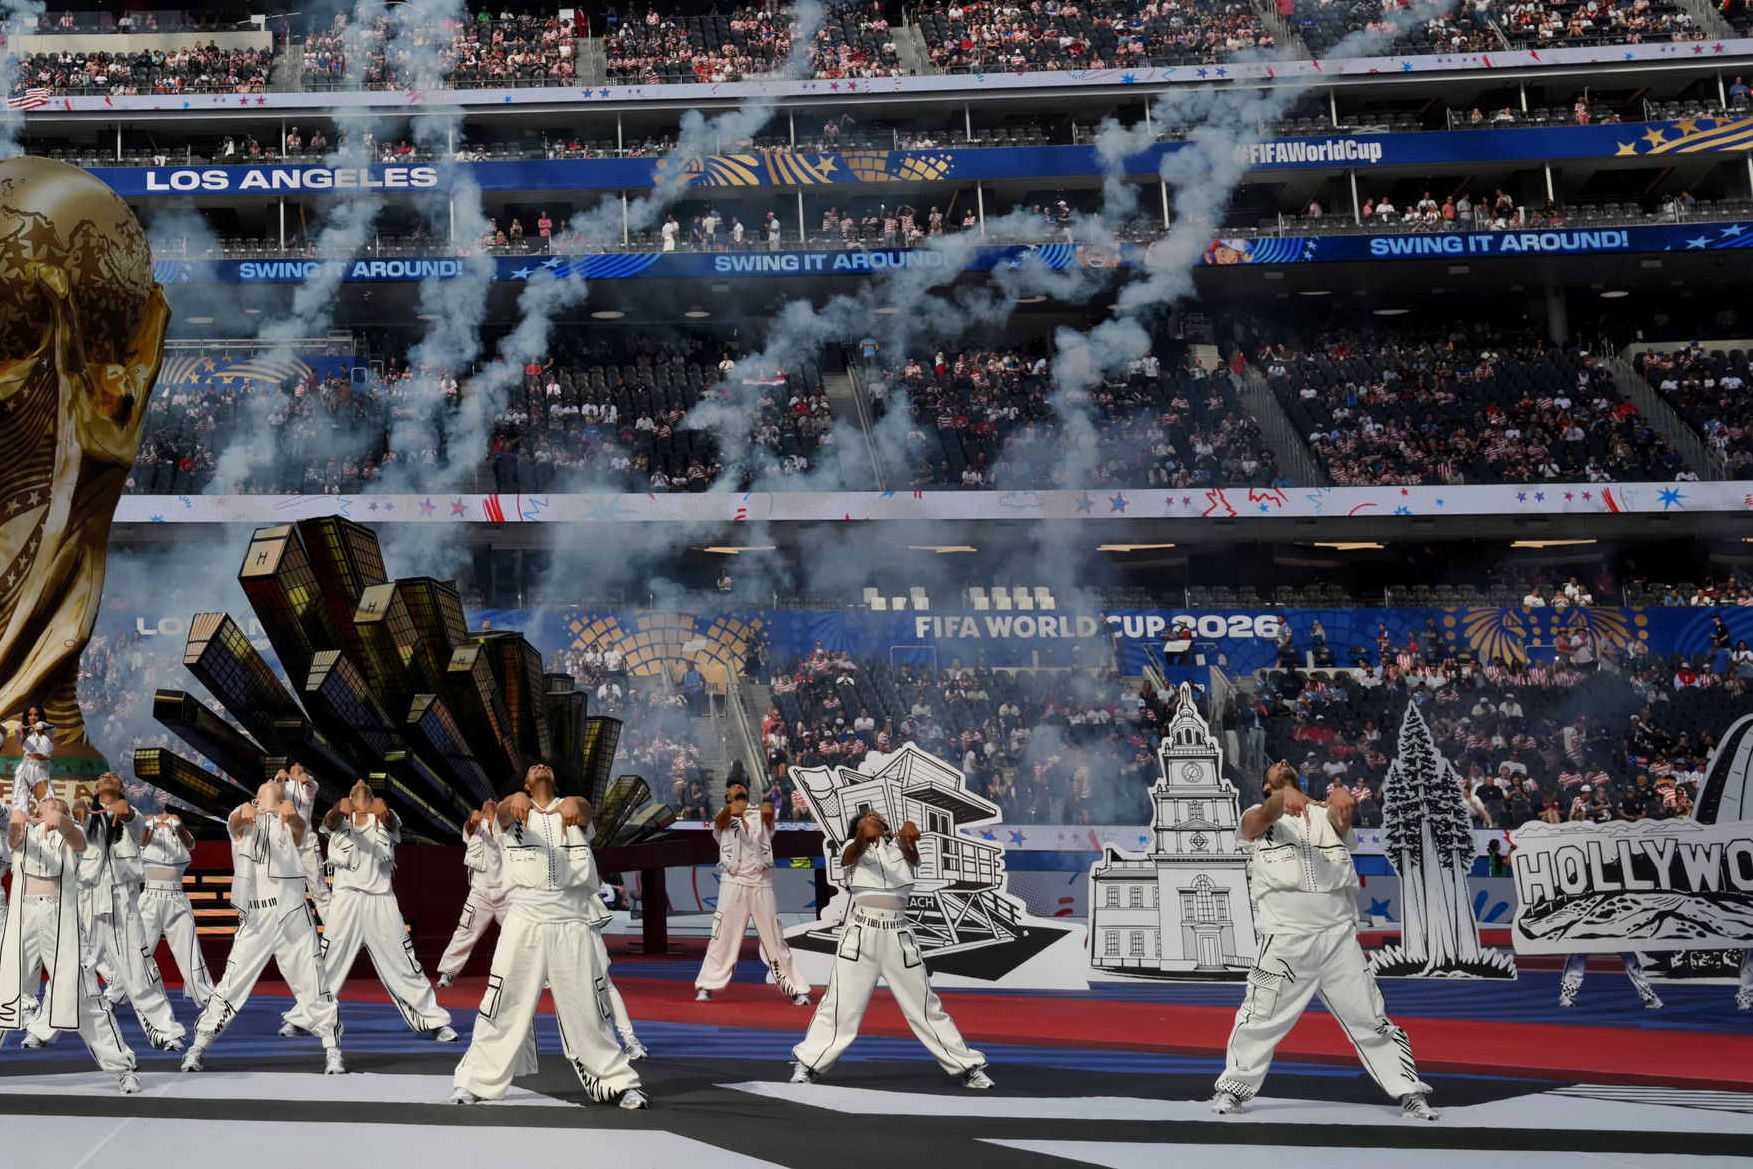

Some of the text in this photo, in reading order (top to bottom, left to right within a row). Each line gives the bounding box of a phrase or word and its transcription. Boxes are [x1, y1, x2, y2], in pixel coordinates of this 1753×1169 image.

[1231, 139, 1382, 164] #FIFAWorldCup
[146, 167, 438, 190] LOS ANGELES
[1370, 231, 1628, 255] SWING IT AROUND!
[239, 262, 320, 278] SWING
[352, 261, 462, 277] AROUND!
[715, 255, 799, 271] SWING
[804, 254, 826, 270] IT
[136, 617, 194, 636] LO
[915, 616, 980, 638] FIFA
[984, 616, 1098, 638] WORLD
[1517, 838, 1753, 905] HOLLYWO
[906, 897, 934, 908] ACH
